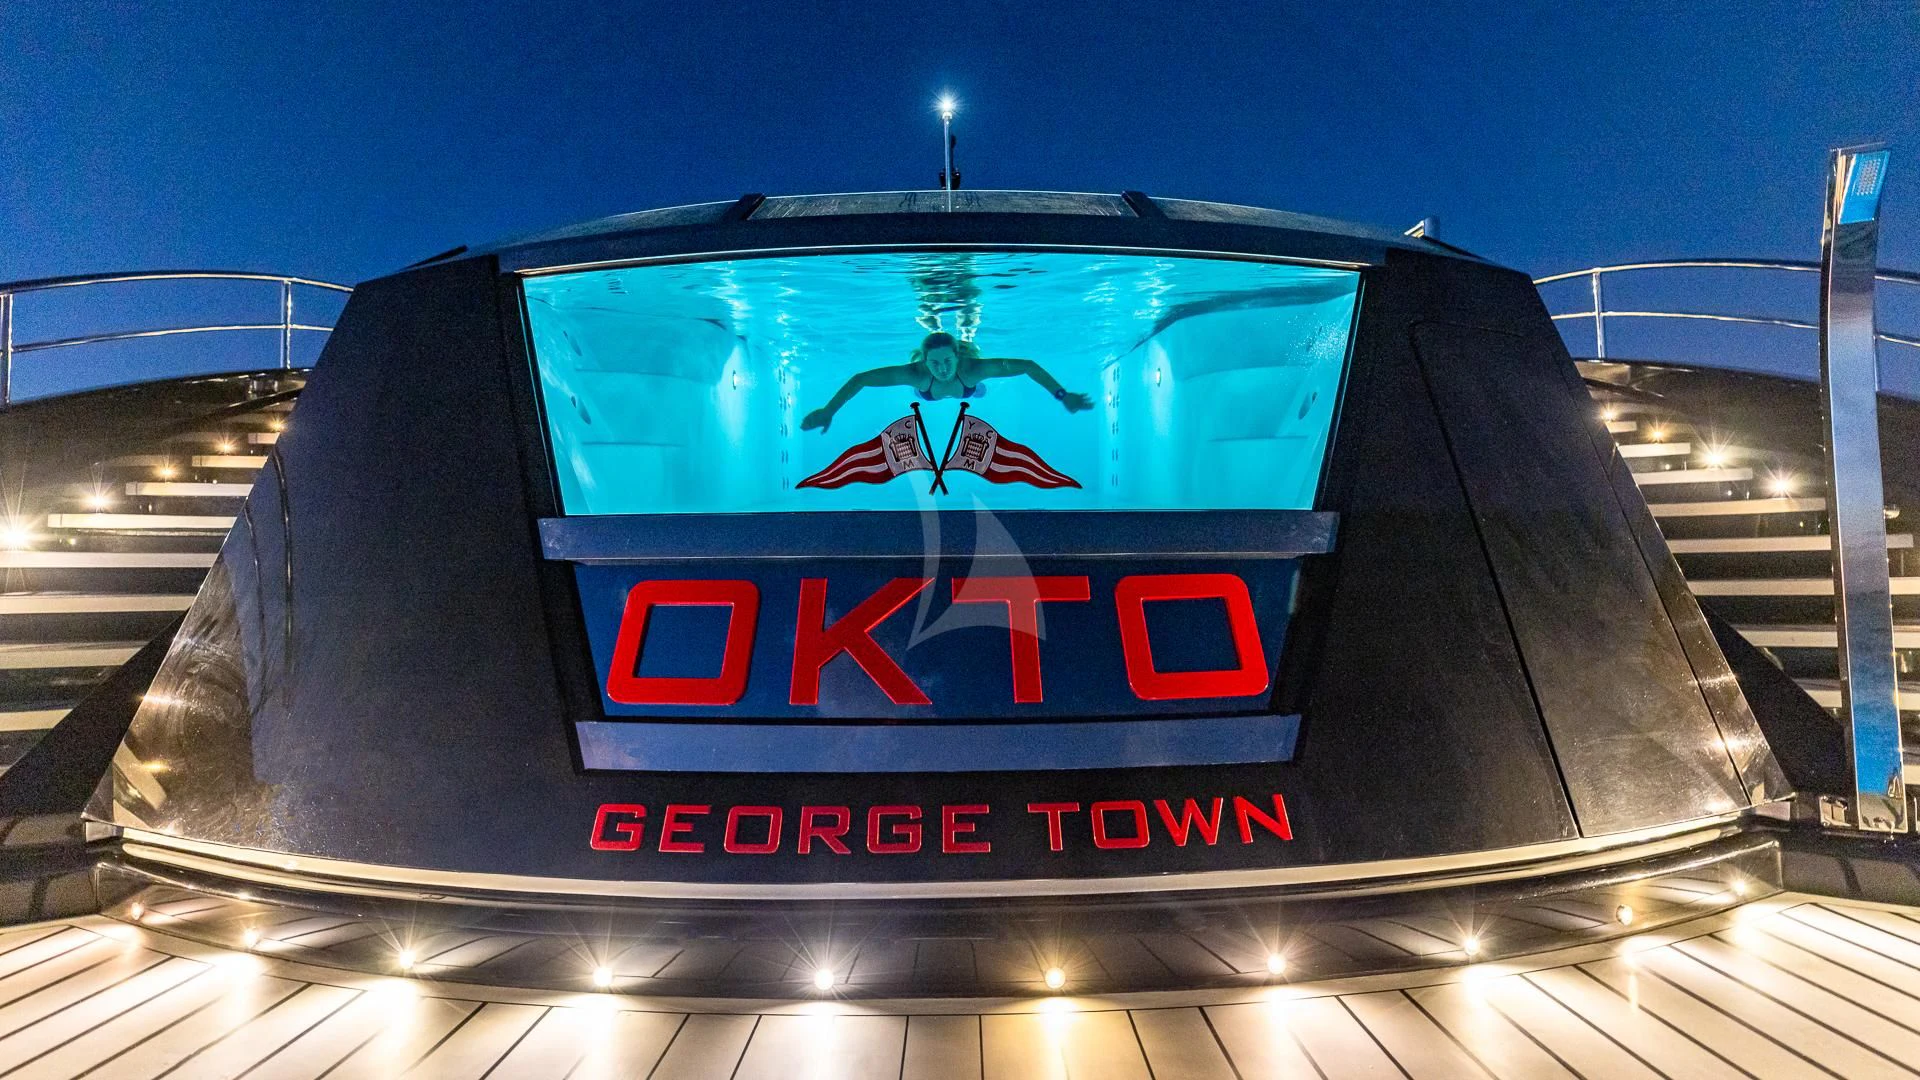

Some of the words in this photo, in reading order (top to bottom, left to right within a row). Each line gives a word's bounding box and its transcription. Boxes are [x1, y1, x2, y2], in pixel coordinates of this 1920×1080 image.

[904, 420, 912, 429] C
[968, 420, 976, 430] Y
[985, 430, 994, 440] C
[902, 459, 915, 470] M
[963, 458, 976, 470] M
[607, 573, 1271, 706] OKTO
[589, 804, 992, 856] GEORGE
[1027, 793, 1294, 852] TOWN
